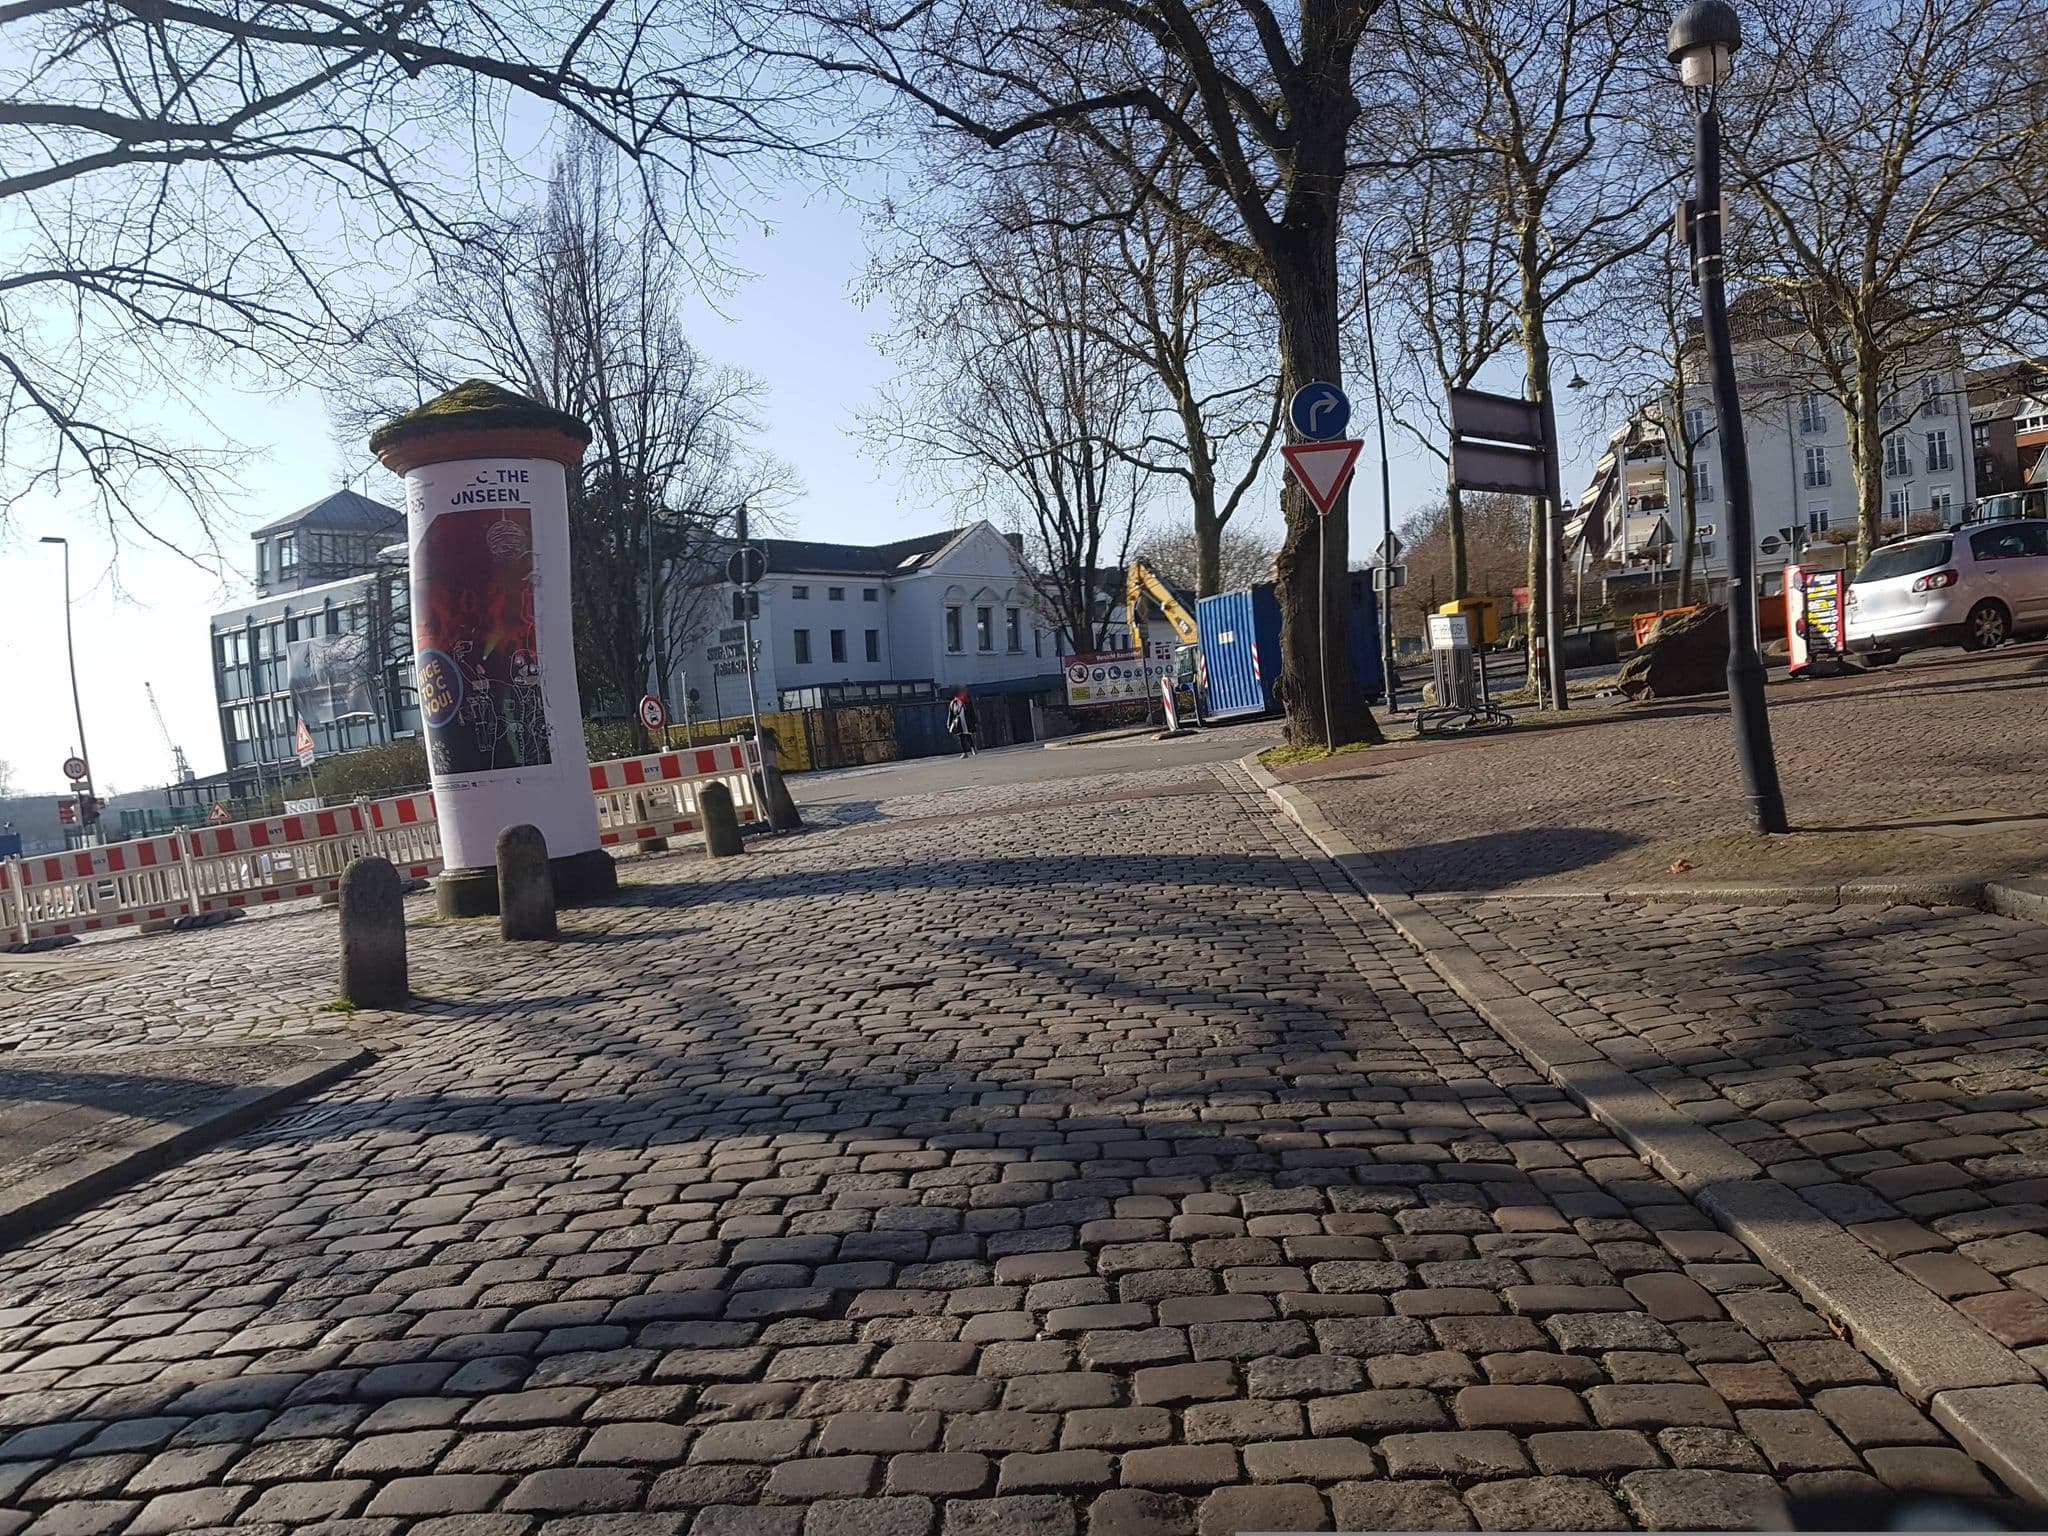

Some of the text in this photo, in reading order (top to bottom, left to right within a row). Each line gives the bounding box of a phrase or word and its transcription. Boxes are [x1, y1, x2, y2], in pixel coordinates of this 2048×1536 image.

[421, 675, 447, 701] TO C
[424, 690, 454, 717] YOU!
[69, 762, 82, 774] 10
